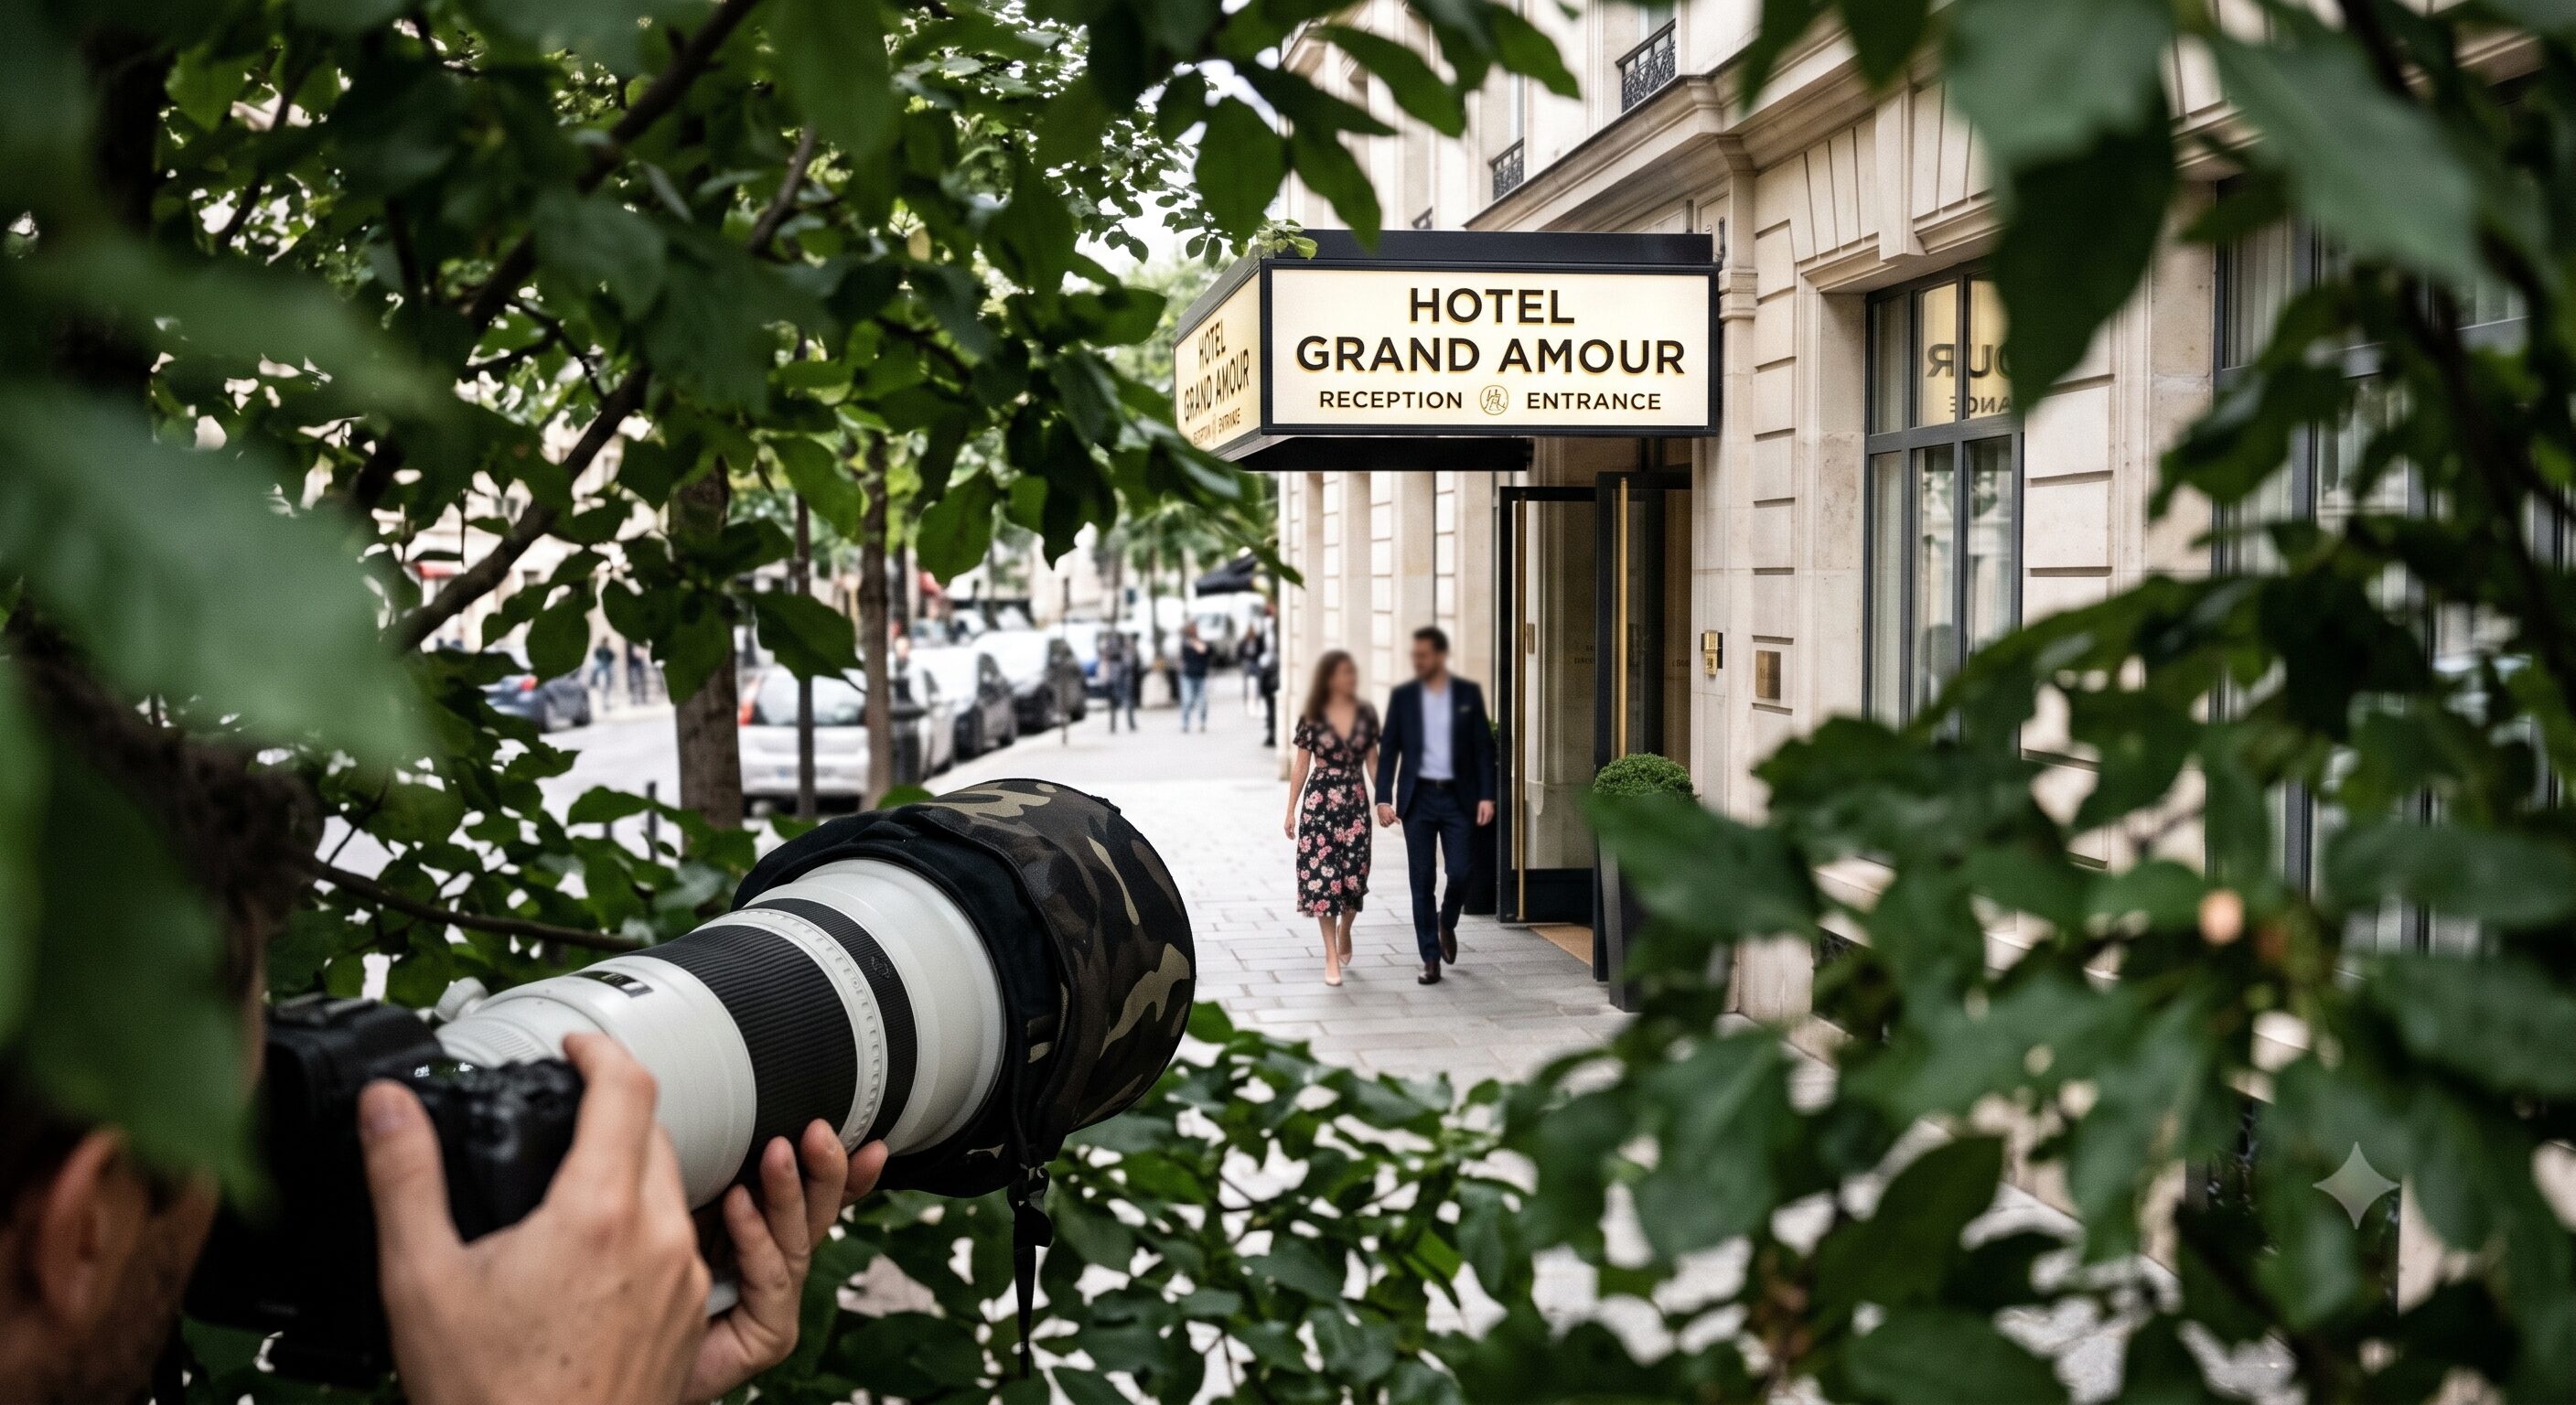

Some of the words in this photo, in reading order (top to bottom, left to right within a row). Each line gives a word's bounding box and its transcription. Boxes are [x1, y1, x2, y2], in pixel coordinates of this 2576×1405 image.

[1411, 287, 1575, 325] HOTEL
[1198, 319, 1226, 370] HOTEL
[1297, 335, 1480, 372] GRAND
[1497, 338, 1685, 375] AMOUR
[1184, 374, 1212, 423] GRAND
[1216, 349, 1250, 404] AMOUR
[1320, 391, 1462, 409] RECEPTION
[1527, 392, 1661, 410] ENTRANCE
